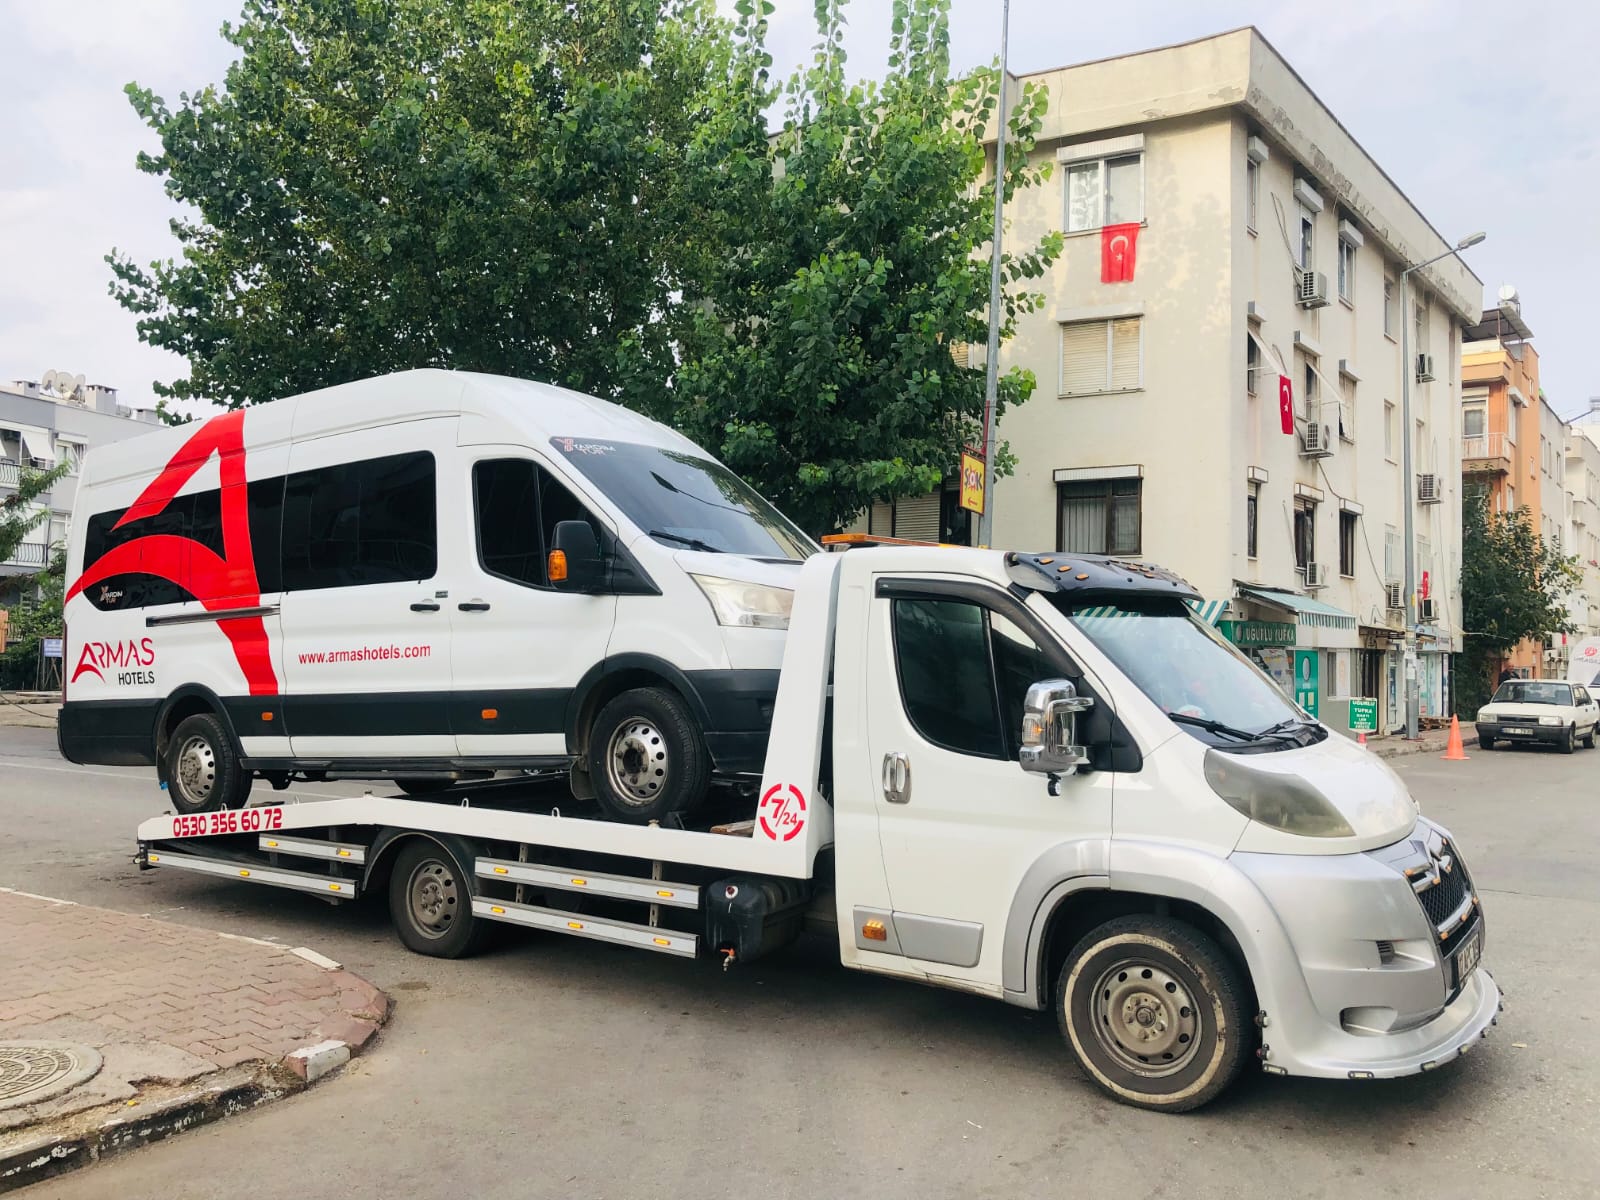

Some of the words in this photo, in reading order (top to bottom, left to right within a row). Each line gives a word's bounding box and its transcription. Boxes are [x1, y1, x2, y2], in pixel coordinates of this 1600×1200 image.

[71, 637, 155, 684] ARMAS
[298, 644, 431, 664] www.armashotels.com
[118, 671, 155, 686] HOTELS
[173, 815, 207, 837] 0530
[210, 811, 237, 834] 356
[241, 809, 260, 832] 60
[263, 807, 283, 830] 72
